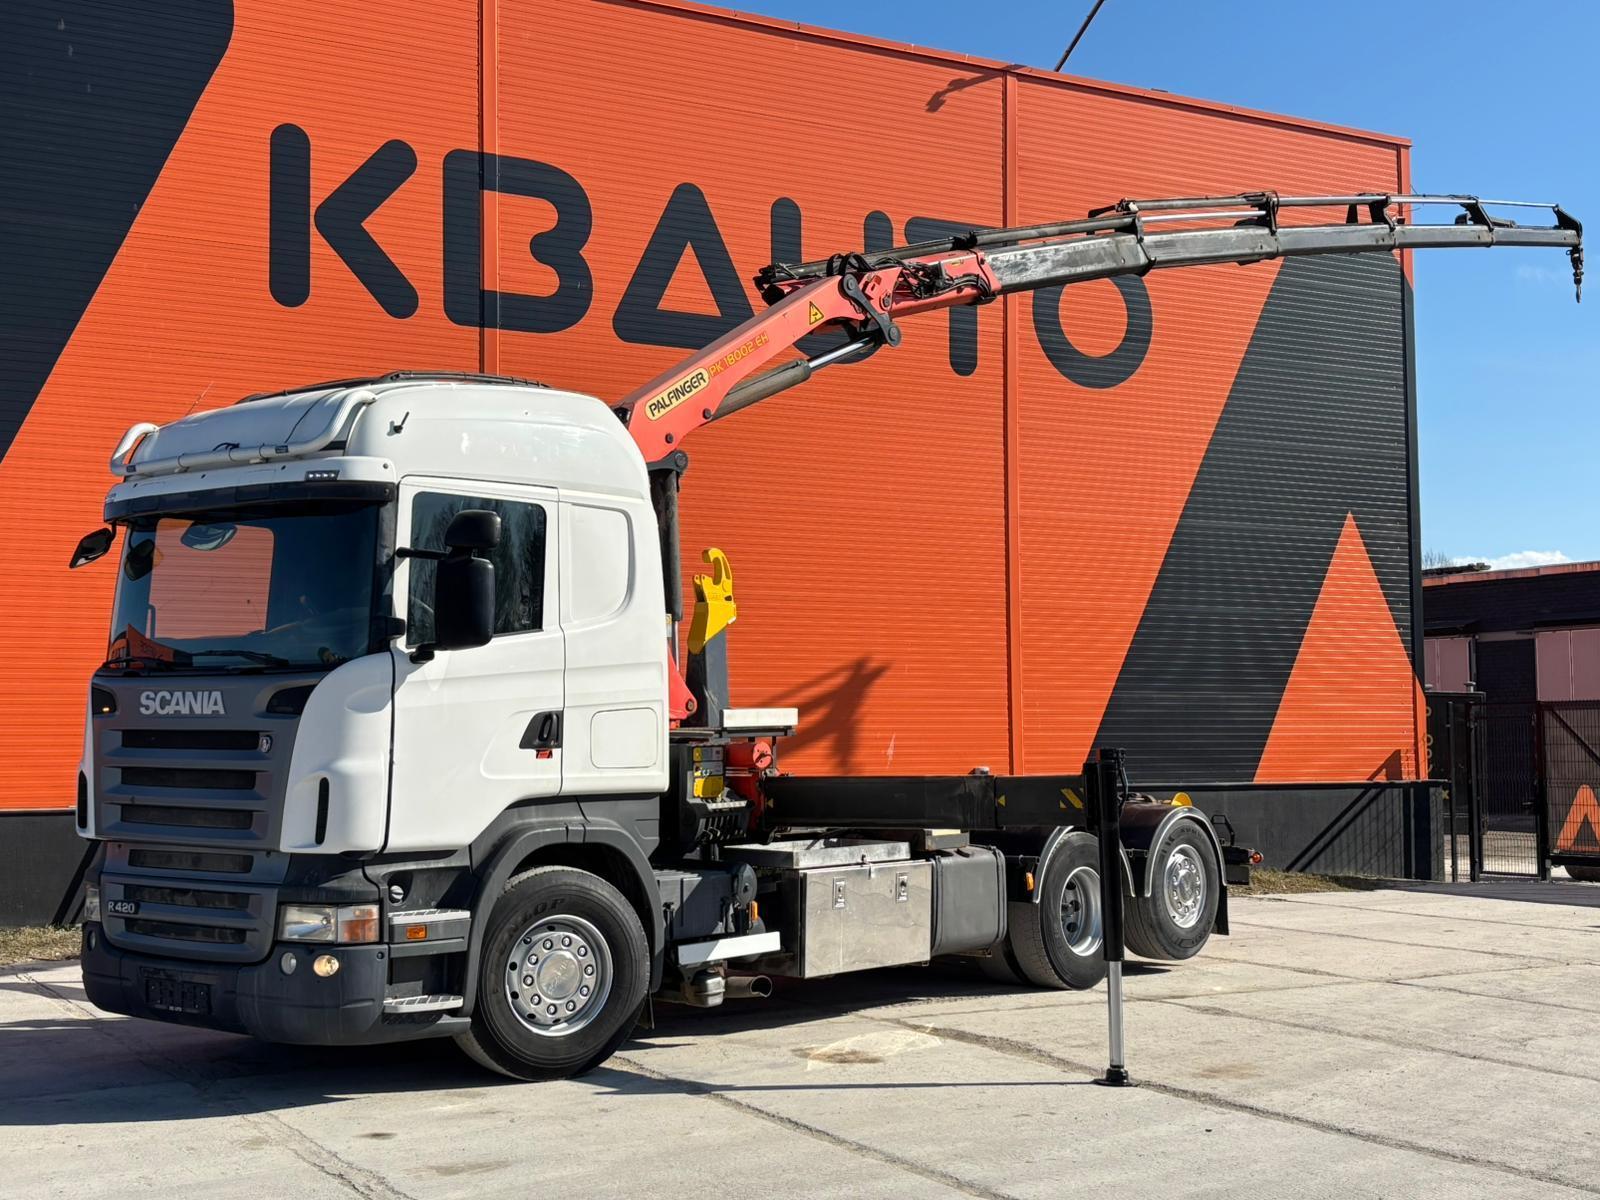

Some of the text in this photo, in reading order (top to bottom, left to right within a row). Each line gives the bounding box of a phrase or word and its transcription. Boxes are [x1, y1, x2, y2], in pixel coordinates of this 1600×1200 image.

[648, 331, 769, 417] PALFINGER PK 18002 EH
[139, 690, 225, 715] SCANIA
